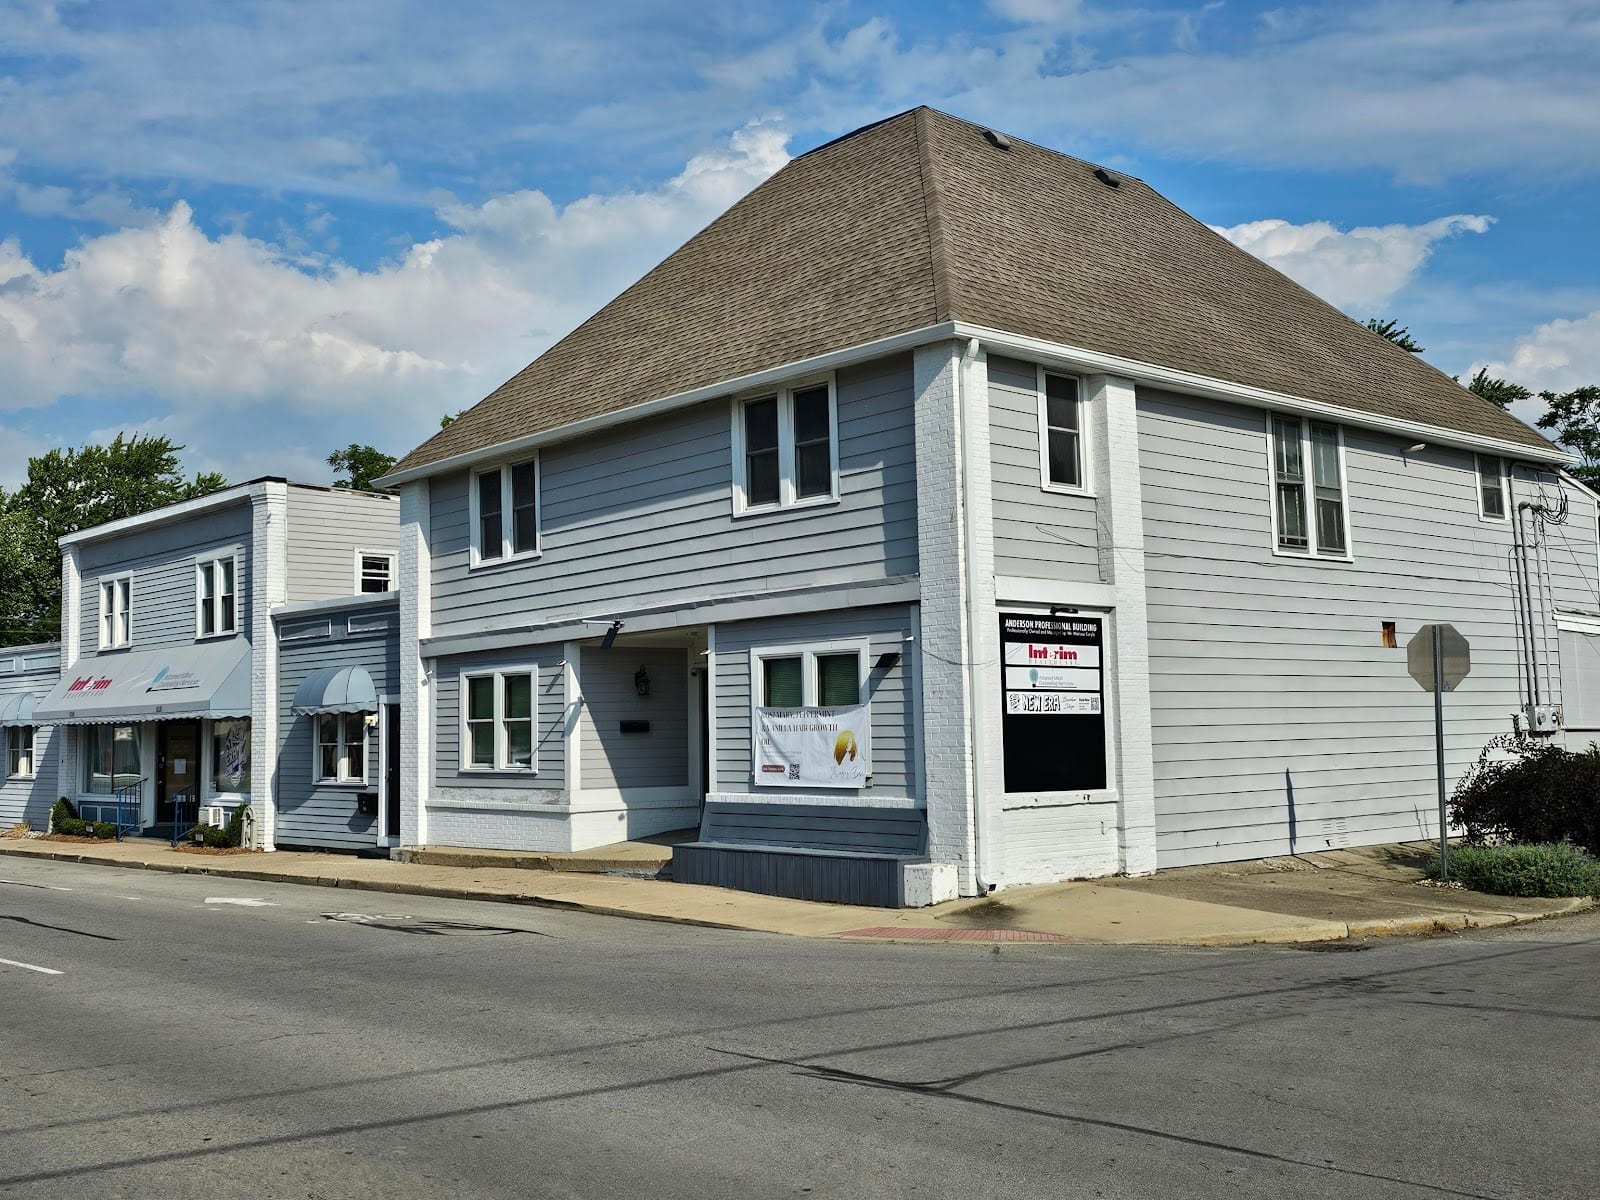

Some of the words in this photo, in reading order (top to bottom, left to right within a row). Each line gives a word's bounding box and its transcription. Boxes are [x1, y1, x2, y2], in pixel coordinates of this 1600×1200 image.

[1005, 619, 1034, 628] ANDERSON
[1035, 621, 1072, 630] PROFESSIONAL
[1073, 623, 1097, 632] BUILDING
[1029, 644, 1077, 660] Interim
[1021, 694, 1042, 712] NEW
[1043, 694, 1061, 712] ERA
[793, 724, 808, 732] HAIR
[809, 724, 838, 732] GROWTH
